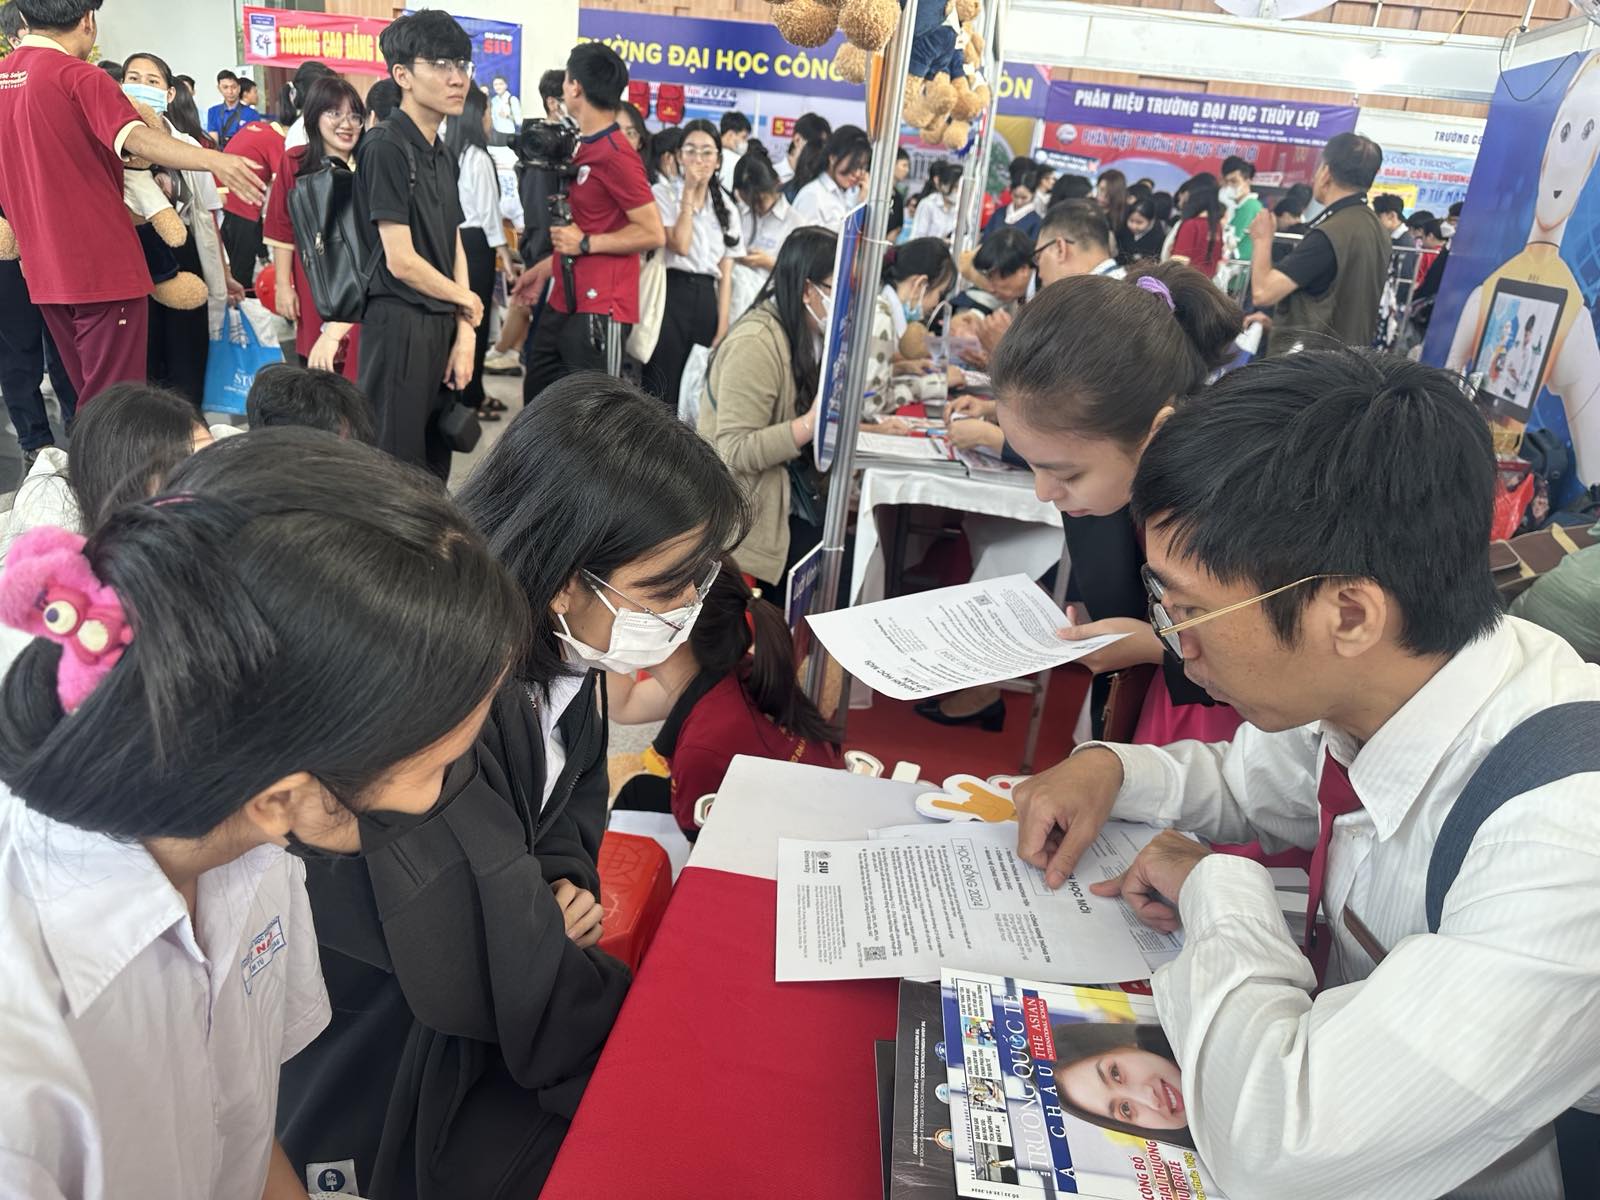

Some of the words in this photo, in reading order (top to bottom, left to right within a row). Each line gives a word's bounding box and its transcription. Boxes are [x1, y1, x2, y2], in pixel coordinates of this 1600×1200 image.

[279, 25, 320, 58] TRƯỜNG
[323, 35, 344, 59] CAO
[345, 25, 374, 61] ĐẲNG
[484, 40, 512, 56] SIU
[668, 46, 709, 74] ĐẠI
[716, 50, 769, 78] HỌC
[774, 52, 844, 82] CÔNG
[703, 86, 737, 98] 2024
[1074, 88, 1111, 109] PHÂN
[1112, 92, 1144, 115] HIỆU
[1147, 95, 1199, 118] TRƯỜNG
[1202, 102, 1225, 123] ĐẠI
[1228, 104, 1258, 126] HỌC
[1260, 104, 1296, 128] THỦY
[1296, 110, 1320, 131] LỢI
[1434, 130, 1470, 144] TRƯỜNG
[957, 845, 970, 862] HỌC
[818, 860, 829, 874] SIU
[963, 864, 980, 888] BỔNG
[968, 890, 984, 906] 2024
[1068, 881, 1083, 898] HỌC
[1076, 899, 1092, 914] MỚI
[1030, 913, 1039, 927] CÔNG
[1000, 994, 1023, 1016] TẾ
[1026, 998, 1041, 1032] ASIAN
[1038, 1000, 1046, 1020] SCHOOL
[1002, 1021, 1033, 1078] QUỐC
[1033, 1036, 1046, 1058] THE
[1042, 1020, 1055, 1060] INTERNATIONAL
[1038, 1064, 1066, 1138] CHÂU
[1013, 1085, 1049, 1169] TRƯỜNG
[1128, 1156, 1146, 1171] BỐ
[1146, 1141, 1166, 1180] THƯỞNG
[1054, 1166, 1076, 1181] Á
[1168, 1160, 1188, 1189] PRIZE
[1137, 1174, 1154, 1200] CÔNG
